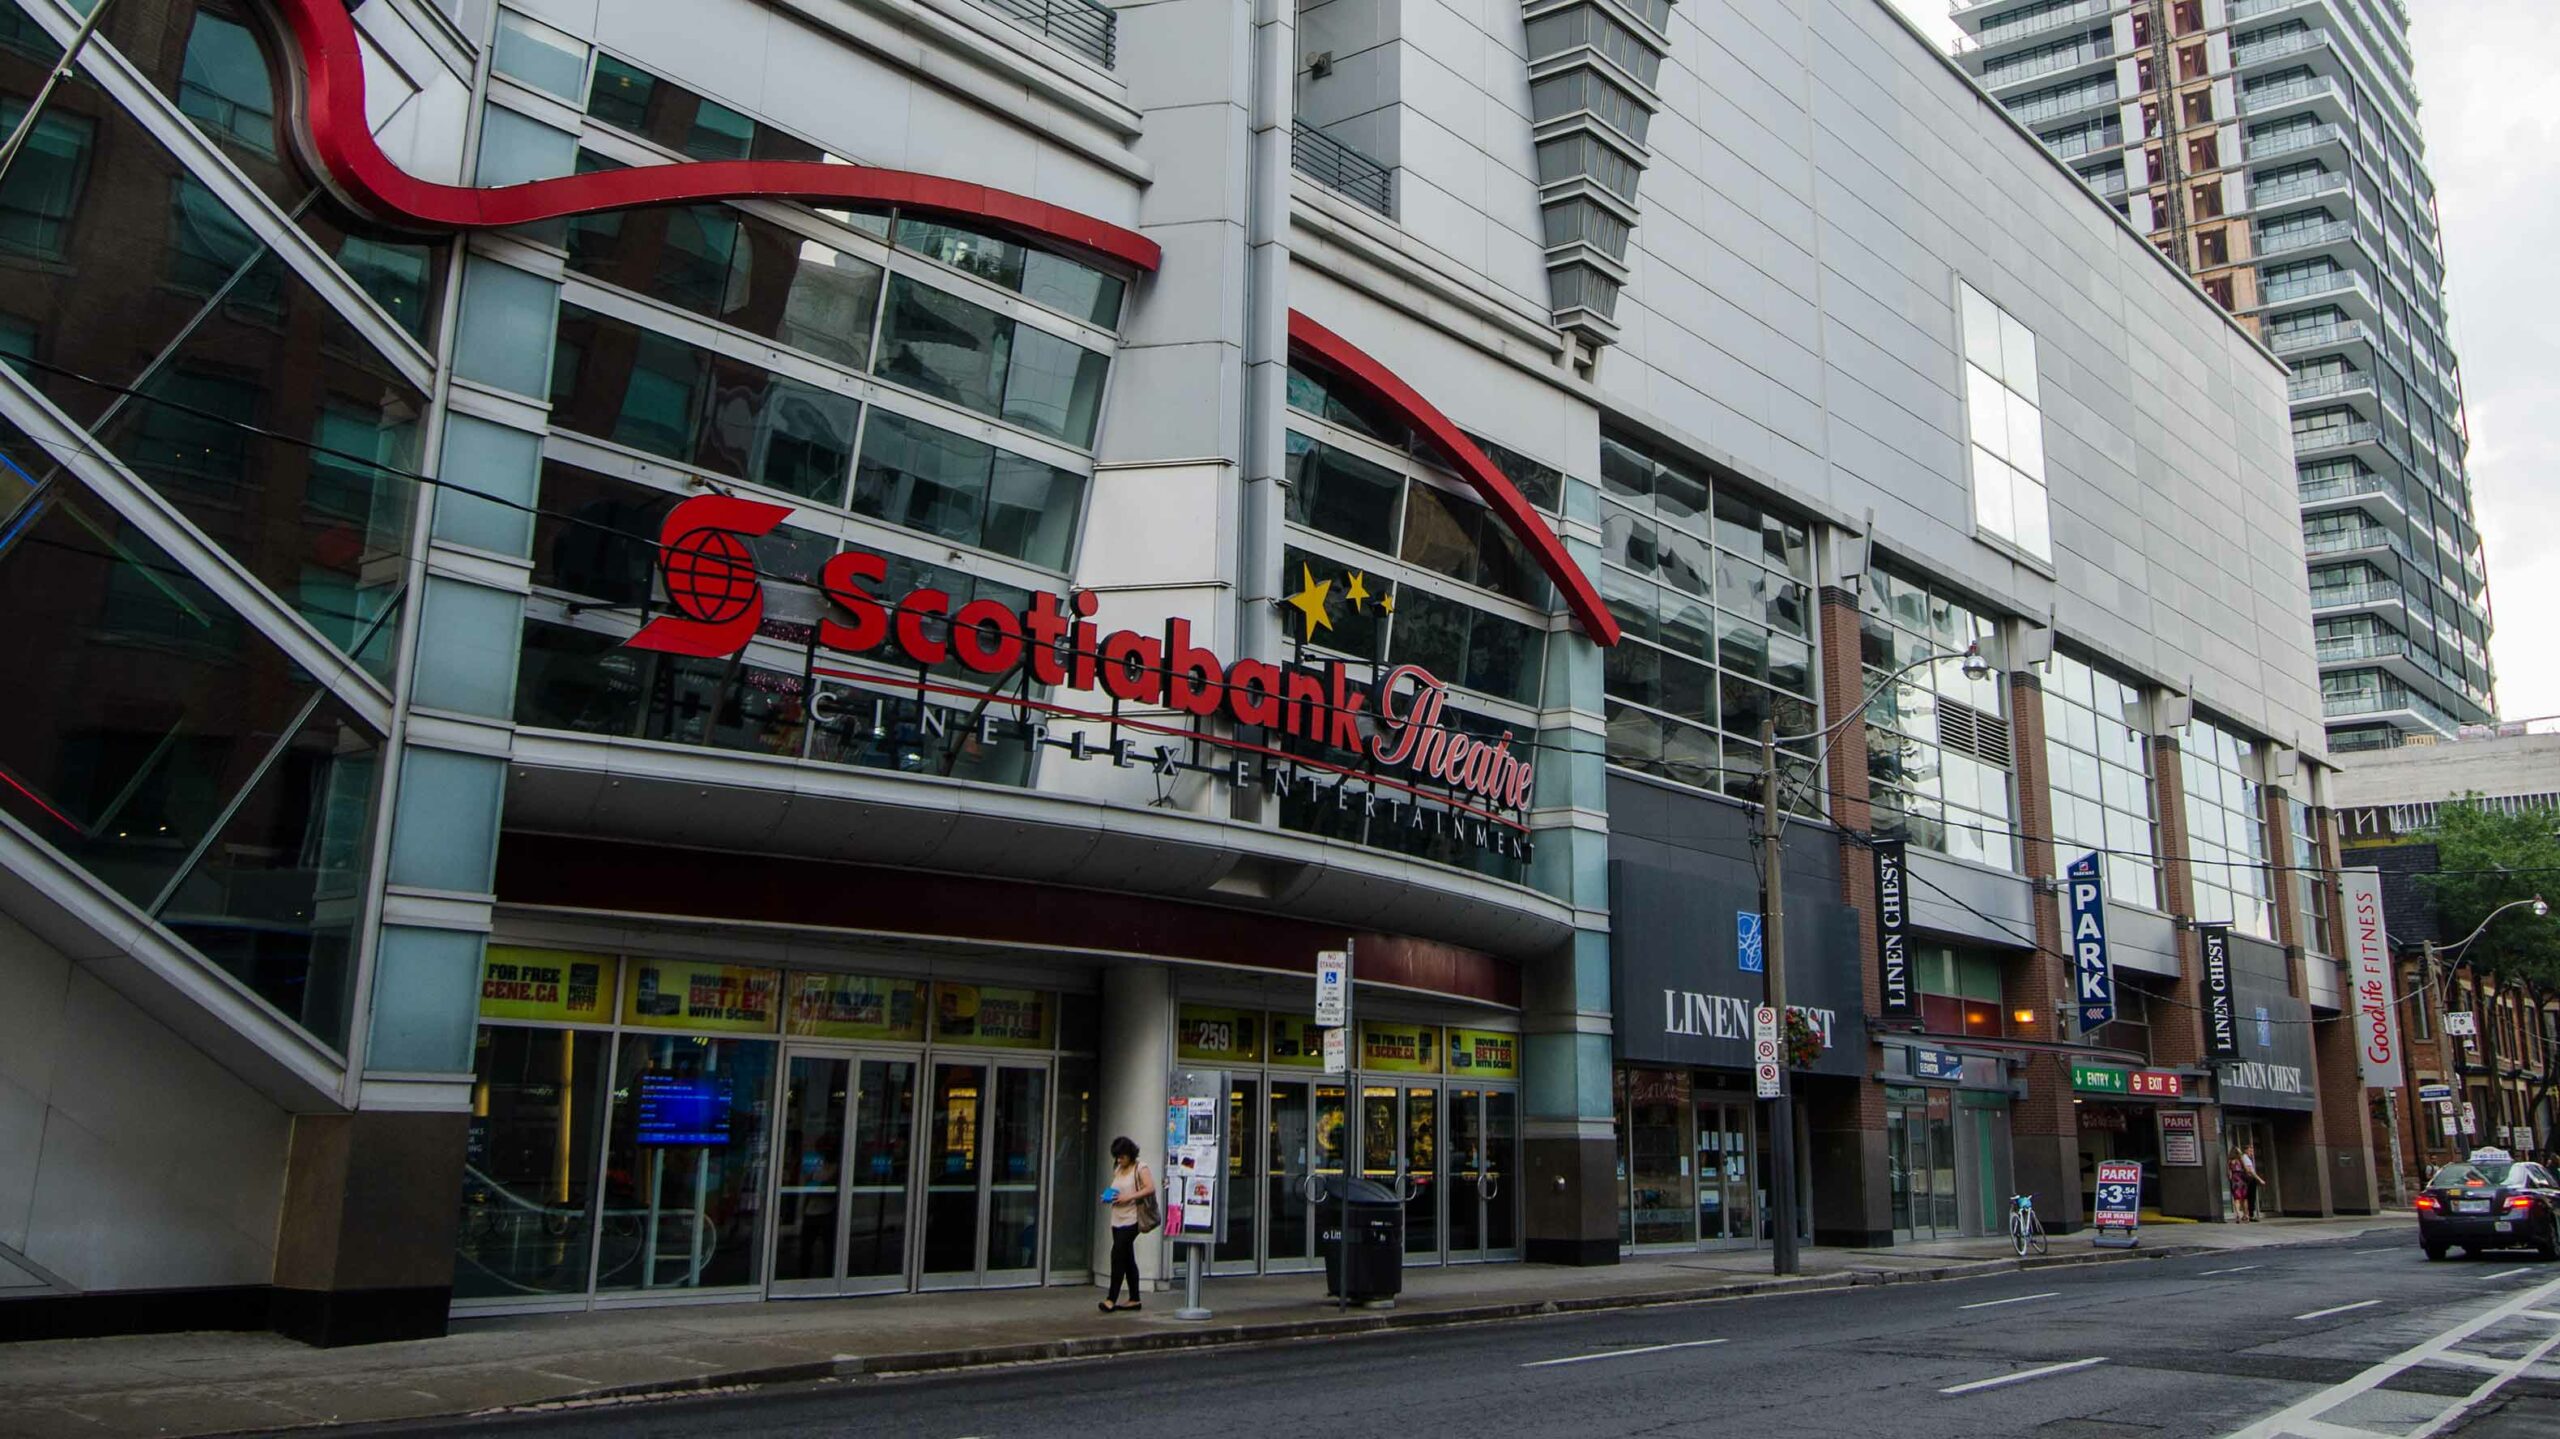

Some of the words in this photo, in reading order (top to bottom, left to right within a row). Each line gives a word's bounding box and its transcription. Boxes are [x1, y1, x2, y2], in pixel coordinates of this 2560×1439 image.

[818, 551, 1365, 753] Scotiabank
[1371, 664, 1534, 811] Theatre
[810, 692, 1181, 776] CINEPLEX
[1235, 760, 1536, 860] ENTERTAINMENT
[1881, 853, 1902, 928] CHEST
[2075, 884, 2107, 999] PARK
[2356, 892, 2381, 974] FITNESS
[488, 963, 519, 981] FOR
[520, 966, 562, 983] FREE
[1885, 934, 1907, 1008] LINEN
[2207, 935, 2226, 992] CHEST
[1199, 1022, 1229, 1051] 259
[1664, 989, 1750, 1040] LINEN
[2213, 996, 2232, 1050] LINEN
[2360, 980, 2391, 1064] GoodLife
[1475, 1047, 1512, 1061] BETTER
[2086, 1072, 2109, 1087] ENTRY
[2231, 1061, 2268, 1090] LINEN
[2267, 1063, 2302, 1094] CHEST
[2148, 1077, 2163, 1090] EXIT
[2164, 1117, 2193, 1128] PARK
[2101, 1168, 2137, 1180] PARK
[2098, 1211, 2112, 1219] CAR
[2113, 1212, 2134, 1220] WASH
